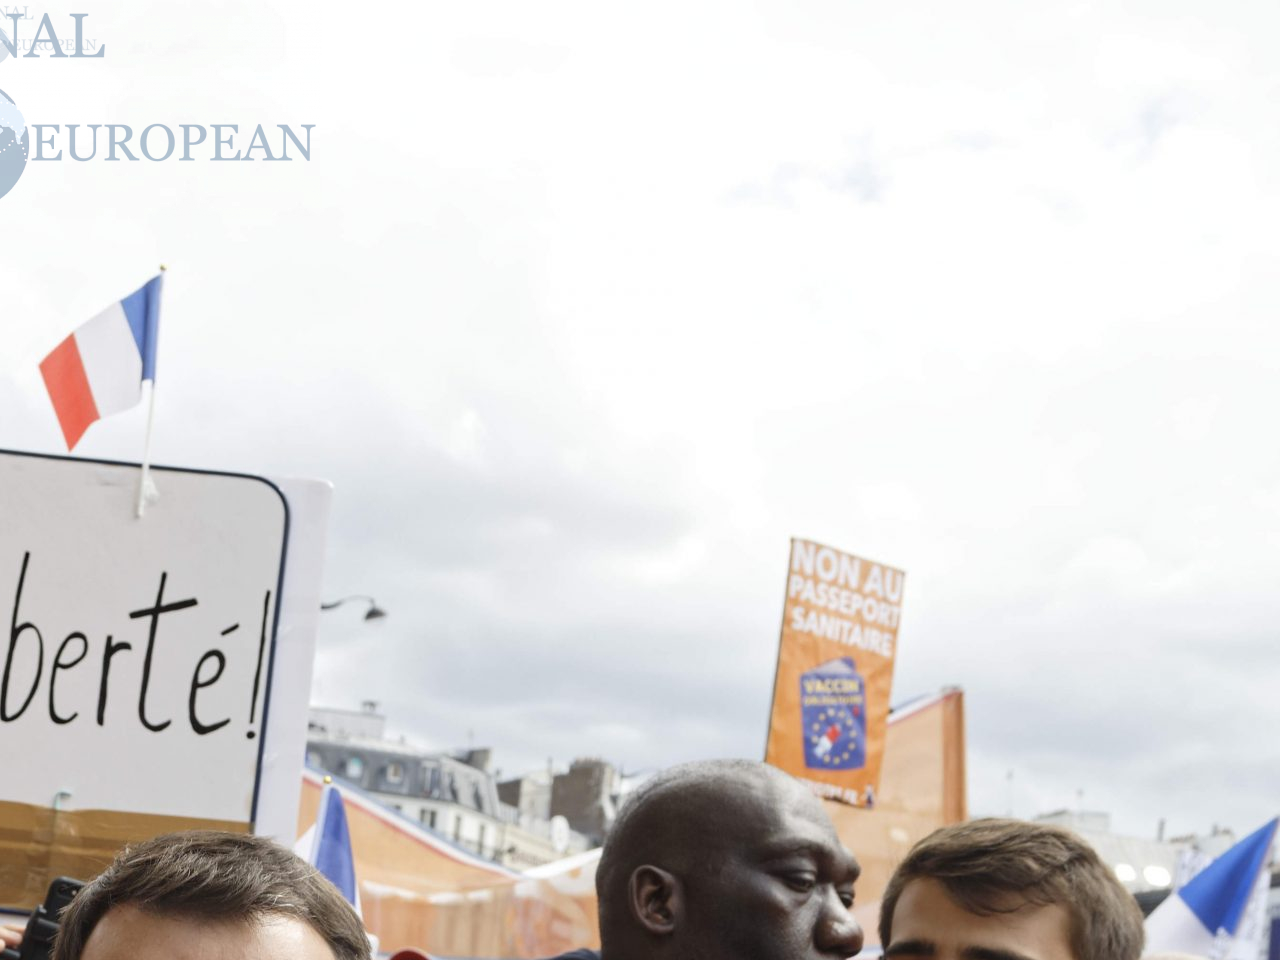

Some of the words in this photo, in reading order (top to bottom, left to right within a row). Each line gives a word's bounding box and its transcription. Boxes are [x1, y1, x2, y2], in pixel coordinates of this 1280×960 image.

[792, 541, 860, 589] NON
[864, 564, 902, 602] AU
[789, 574, 901, 627] PASSEPORT
[792, 605, 893, 657] SANITAIRE
